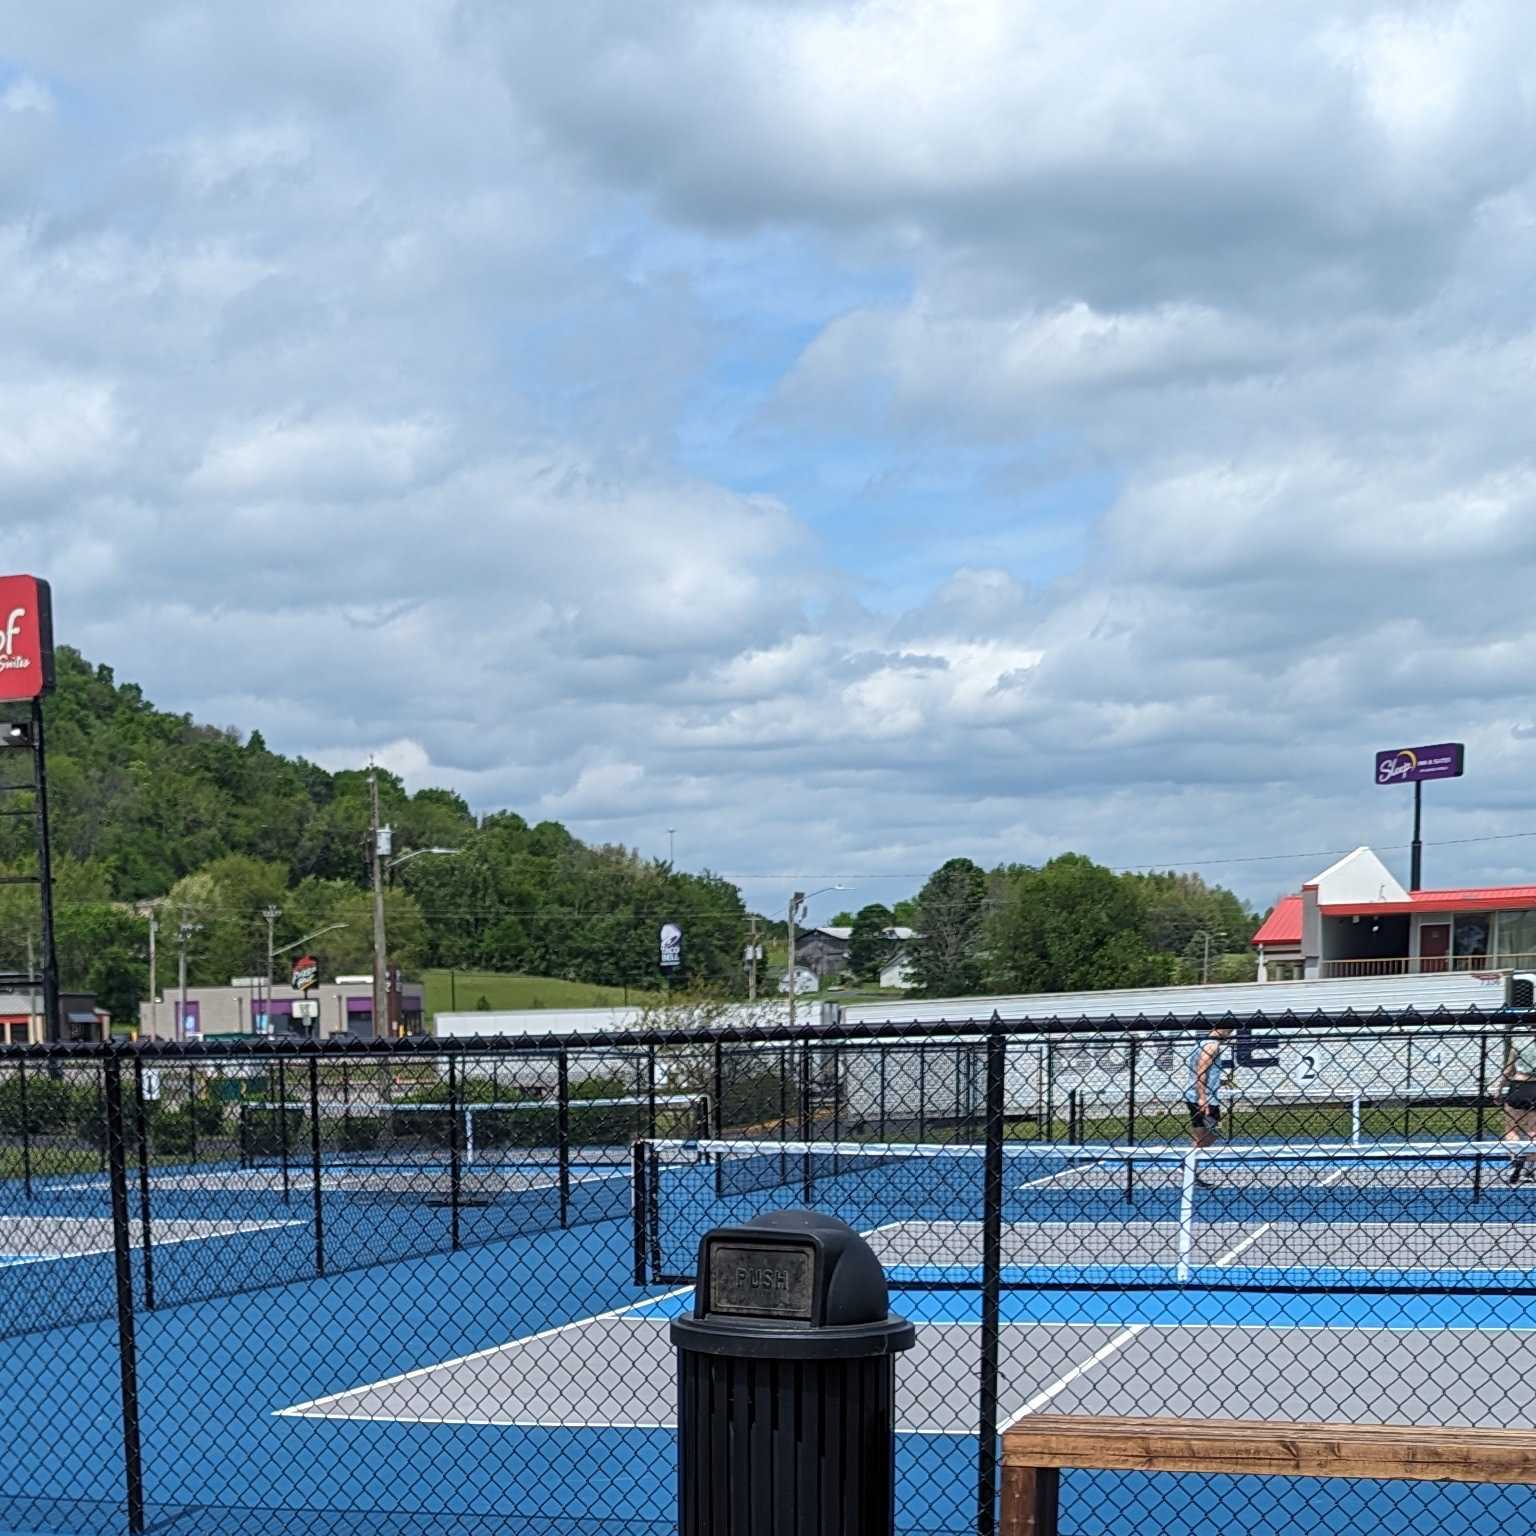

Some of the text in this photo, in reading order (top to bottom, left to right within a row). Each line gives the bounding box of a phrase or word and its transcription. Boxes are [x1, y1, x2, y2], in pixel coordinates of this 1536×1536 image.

[1378, 757, 1412, 783] Sleep
[1301, 1056, 1315, 1079] 2
[735, 1266, 790, 1291] PUSH
